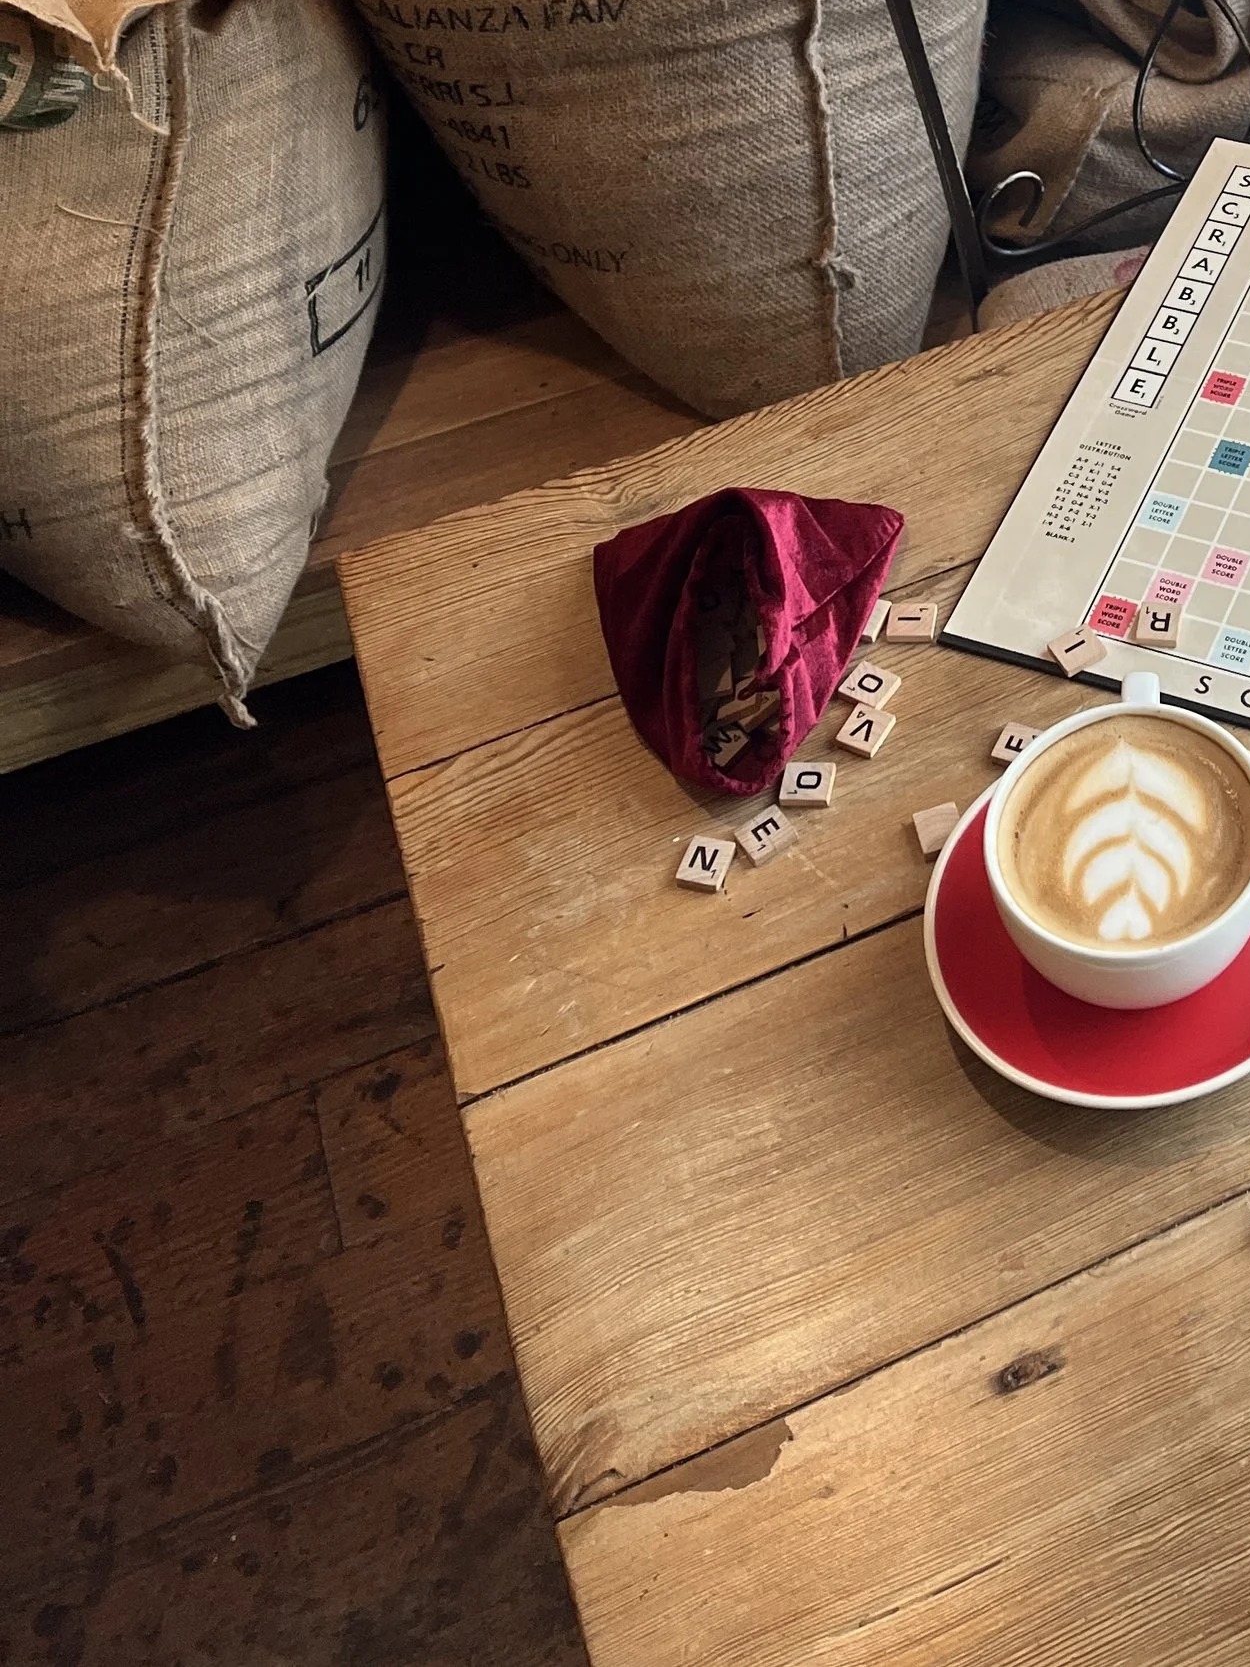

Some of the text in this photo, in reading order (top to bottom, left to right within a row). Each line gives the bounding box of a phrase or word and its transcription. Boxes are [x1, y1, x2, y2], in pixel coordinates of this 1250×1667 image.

[1214, 553, 1243, 565] DOUBLE
[1213, 560, 1238, 572] WORD
[1210, 568, 1234, 579] SCORE
[1104, 602, 1128, 613] TRIPLE
[1099, 609, 1124, 621] WORD
[1096, 617, 1121, 629] SCORE
[1150, 612, 1171, 632] R
[1222, 643, 1247, 655] LETTER
[1219, 651, 1244, 663] SCORE
[857, 672, 884, 694] O
[796, 771, 822, 791] O
[751, 817, 781, 843] E
[689, 845, 720, 872] N
